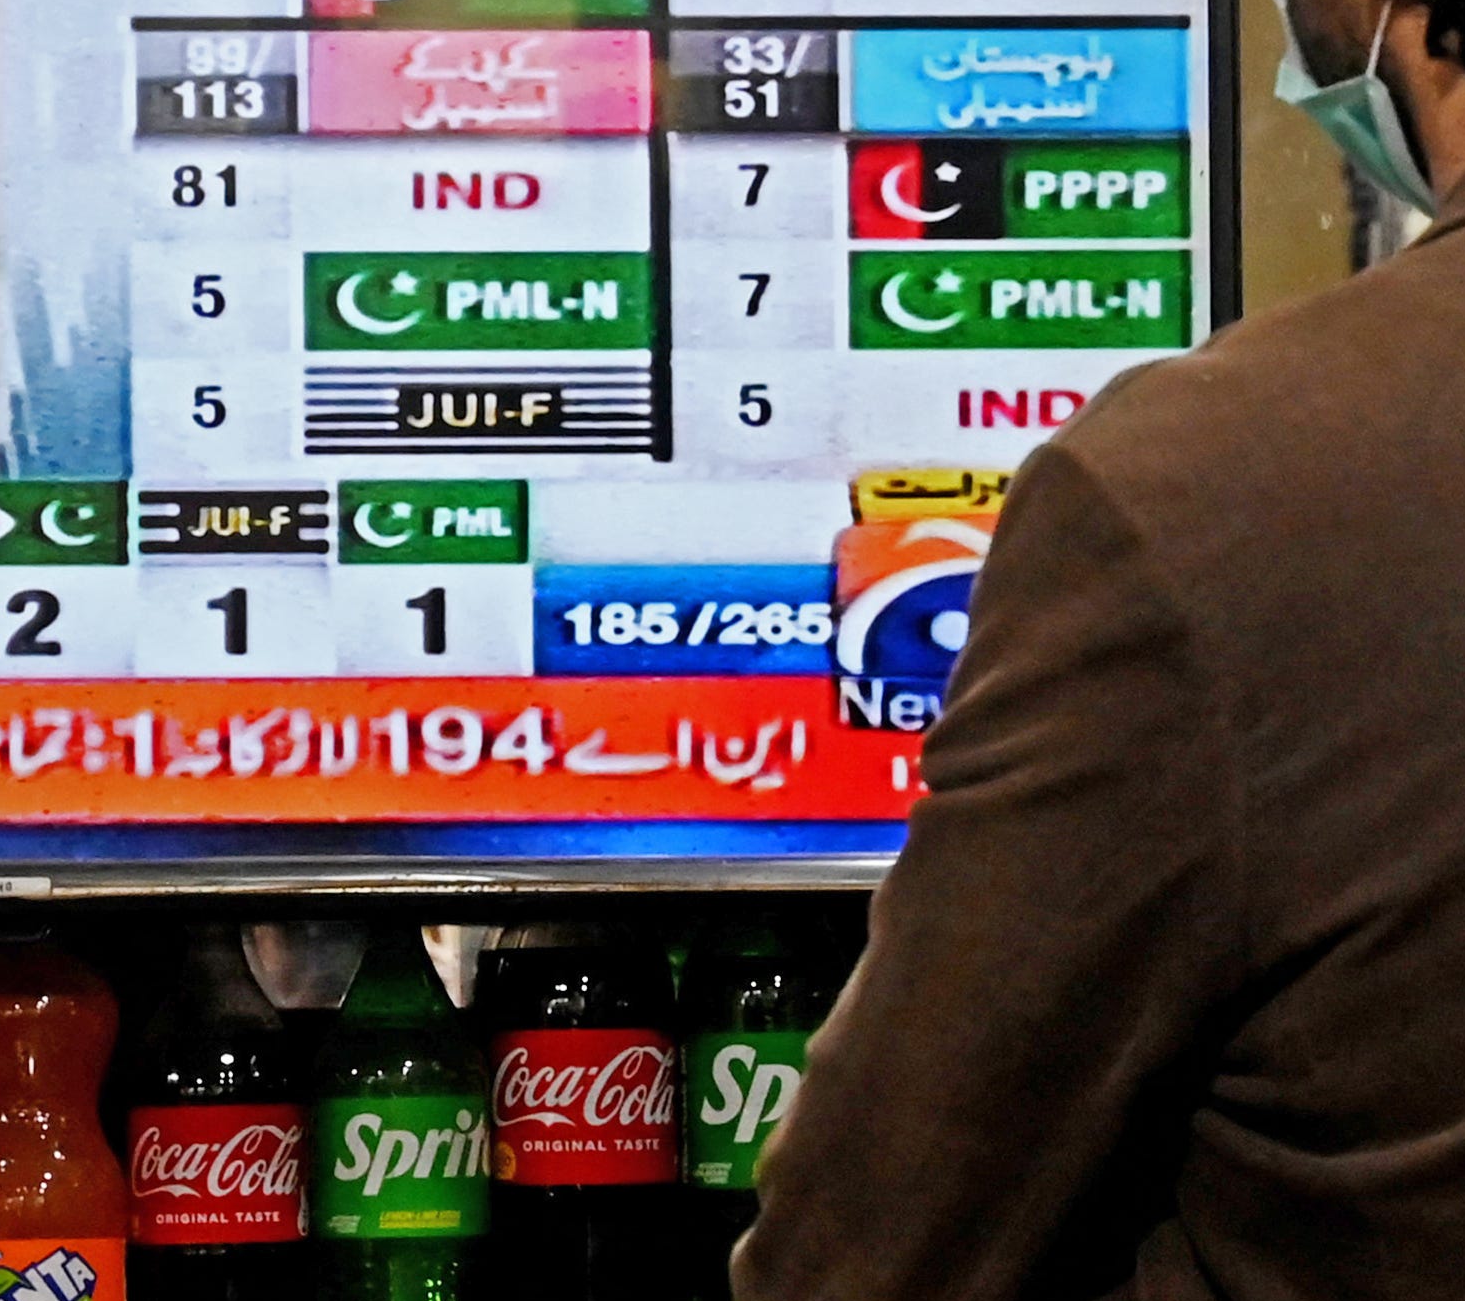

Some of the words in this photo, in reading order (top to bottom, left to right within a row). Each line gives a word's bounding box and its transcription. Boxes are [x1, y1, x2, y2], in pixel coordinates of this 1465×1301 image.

[723, 35, 825, 78] 33/
[172, 80, 265, 119] 113
[723, 80, 780, 118] 51
[172, 164, 238, 207] 81
[412, 172, 540, 210] IND
[738, 163, 770, 207] 7
[1024, 170, 1168, 210] PPPP
[191, 274, 226, 318] 5
[445, 280, 618, 321] PML-N
[738, 273, 771, 316] 7
[990, 279, 1162, 320] PML-N
[191, 385, 227, 428] 5
[406, 392, 553, 427] JUI-F
[738, 383, 773, 427] 5
[957, 389, 1087, 429] IND
[187, 504, 291, 538] JUI-F
[431, 505, 512, 536] PML
[4, 588, 63, 657] 2
[207, 587, 248, 655] 1
[405, 587, 446, 655] 1
[374, 704, 554, 776] 194
[493, 1046, 675, 1129] Coca-Cola
[131, 1124, 300, 1197] Coca-Cola
[522, 1139, 608, 1154] ORIGINAL
[612, 1138, 661, 1152] TASTE
[155, 1212, 228, 1226] ORIGINAL
[234, 1210, 281, 1224] TASTE
